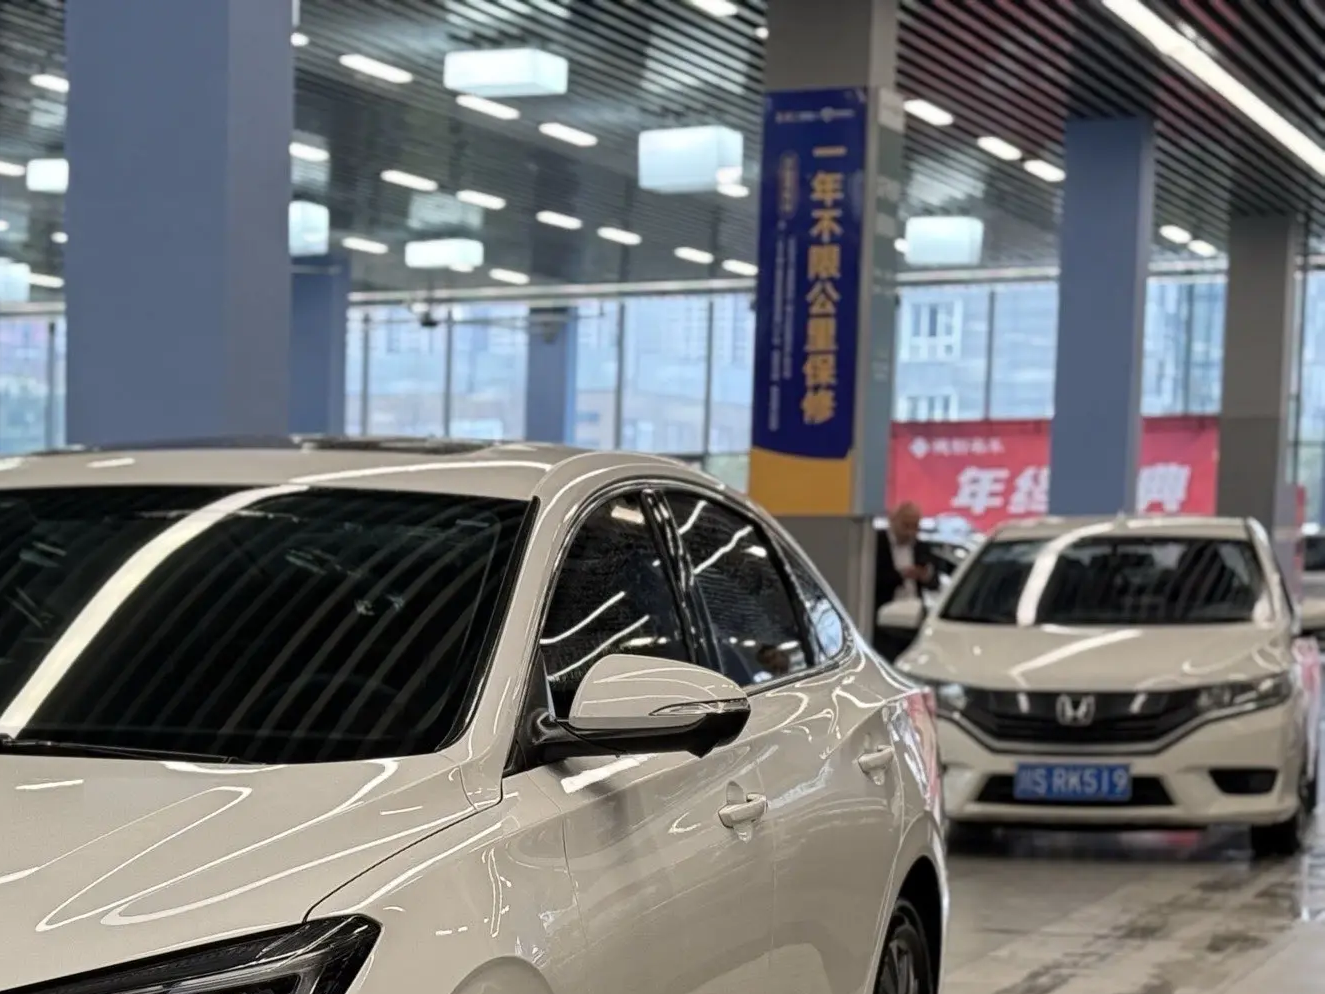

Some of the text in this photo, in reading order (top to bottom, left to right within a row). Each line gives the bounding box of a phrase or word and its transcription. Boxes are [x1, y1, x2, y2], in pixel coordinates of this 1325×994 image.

[801, 145, 848, 425] 一年不限公里保修
